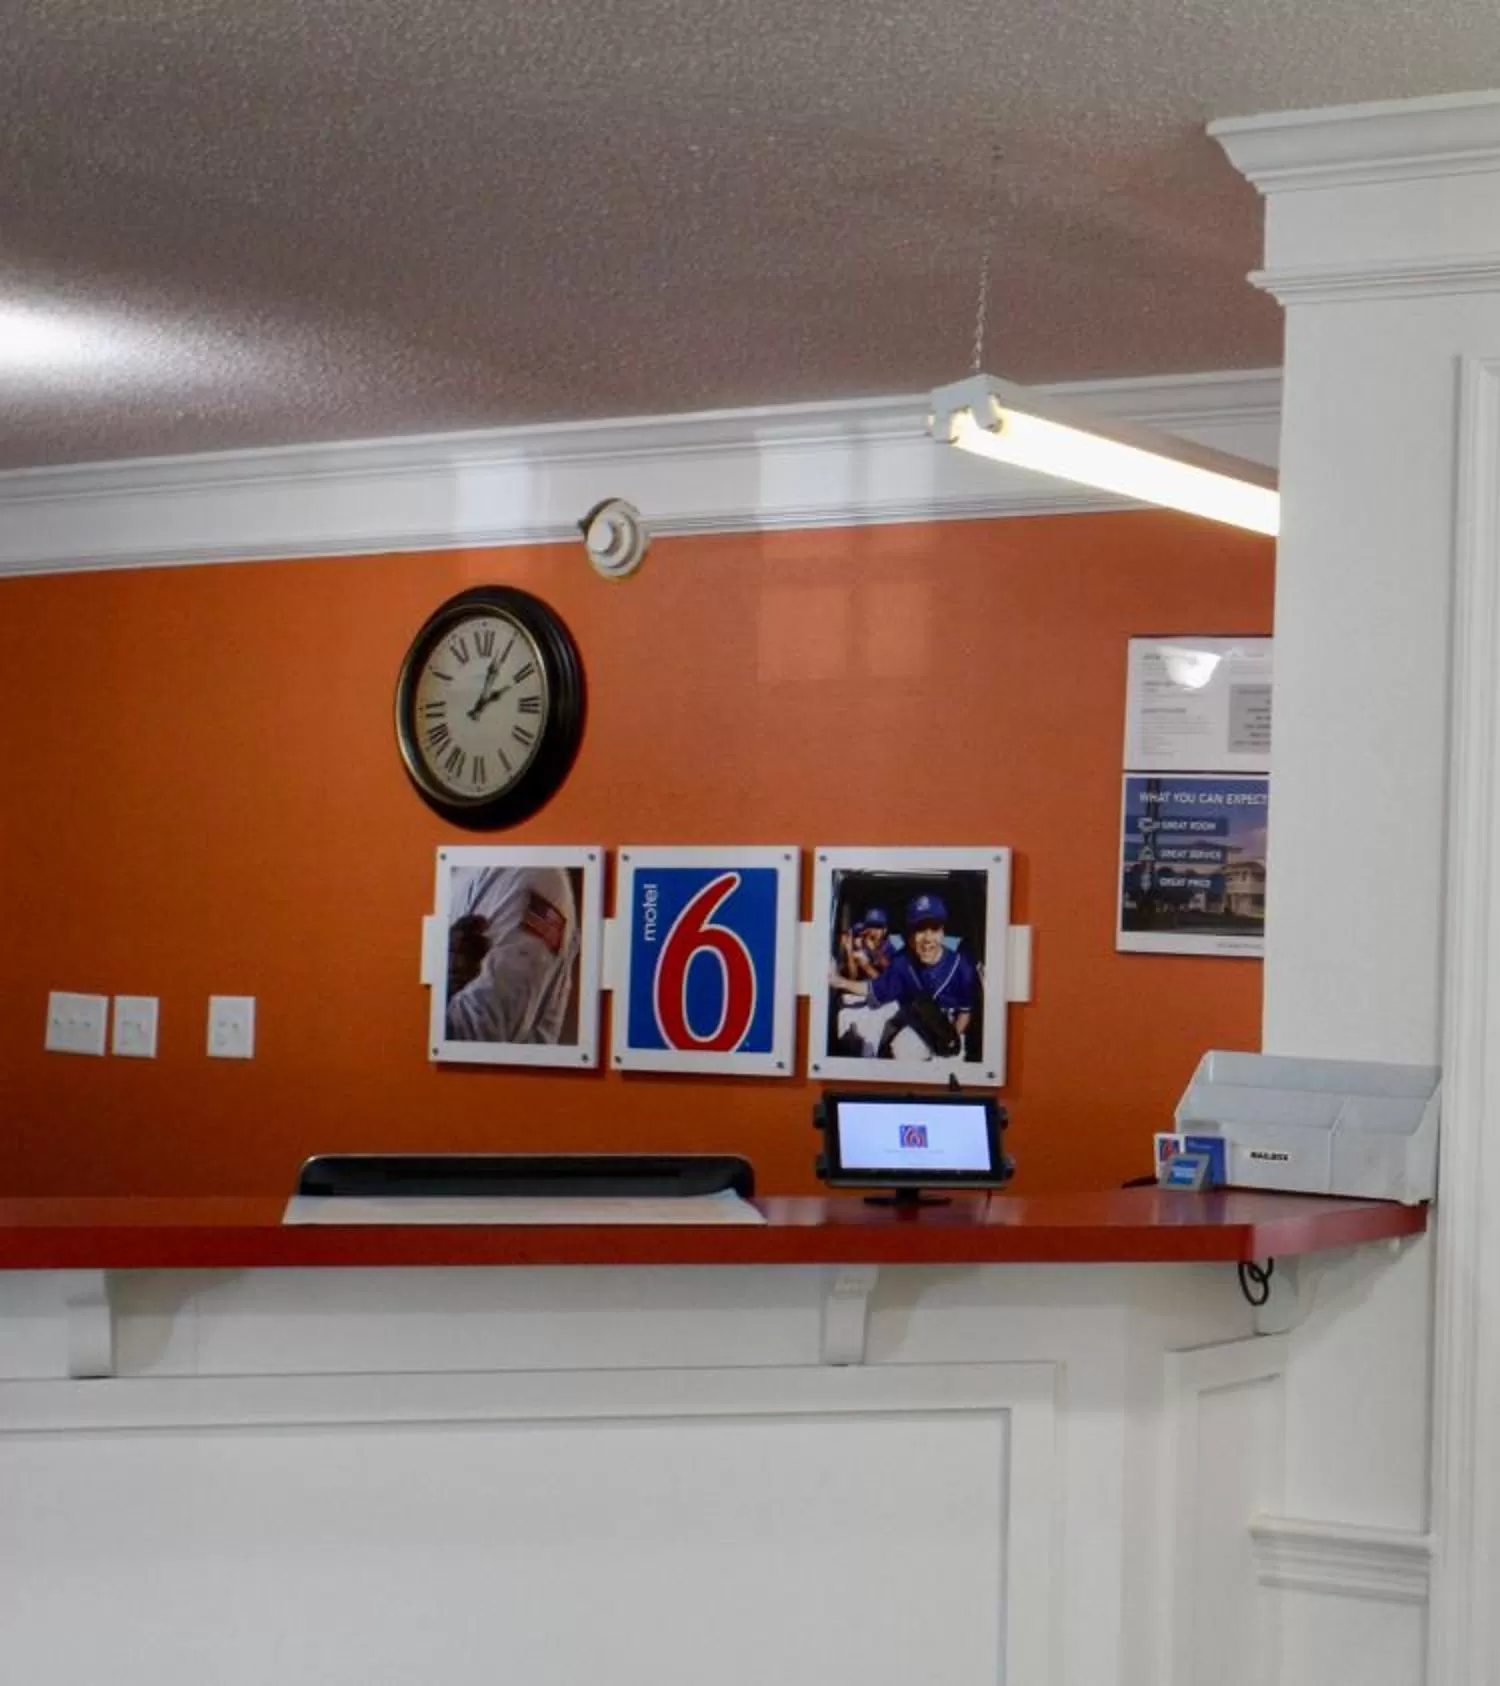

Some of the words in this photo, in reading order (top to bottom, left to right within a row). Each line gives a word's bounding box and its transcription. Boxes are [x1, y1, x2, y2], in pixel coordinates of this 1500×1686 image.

[1139, 792, 1171, 803] WHAT
[1173, 793, 1196, 803] YOU
[1199, 793, 1223, 804] CAN
[643, 883, 658, 942] motel
[653, 871, 757, 1052] 6
